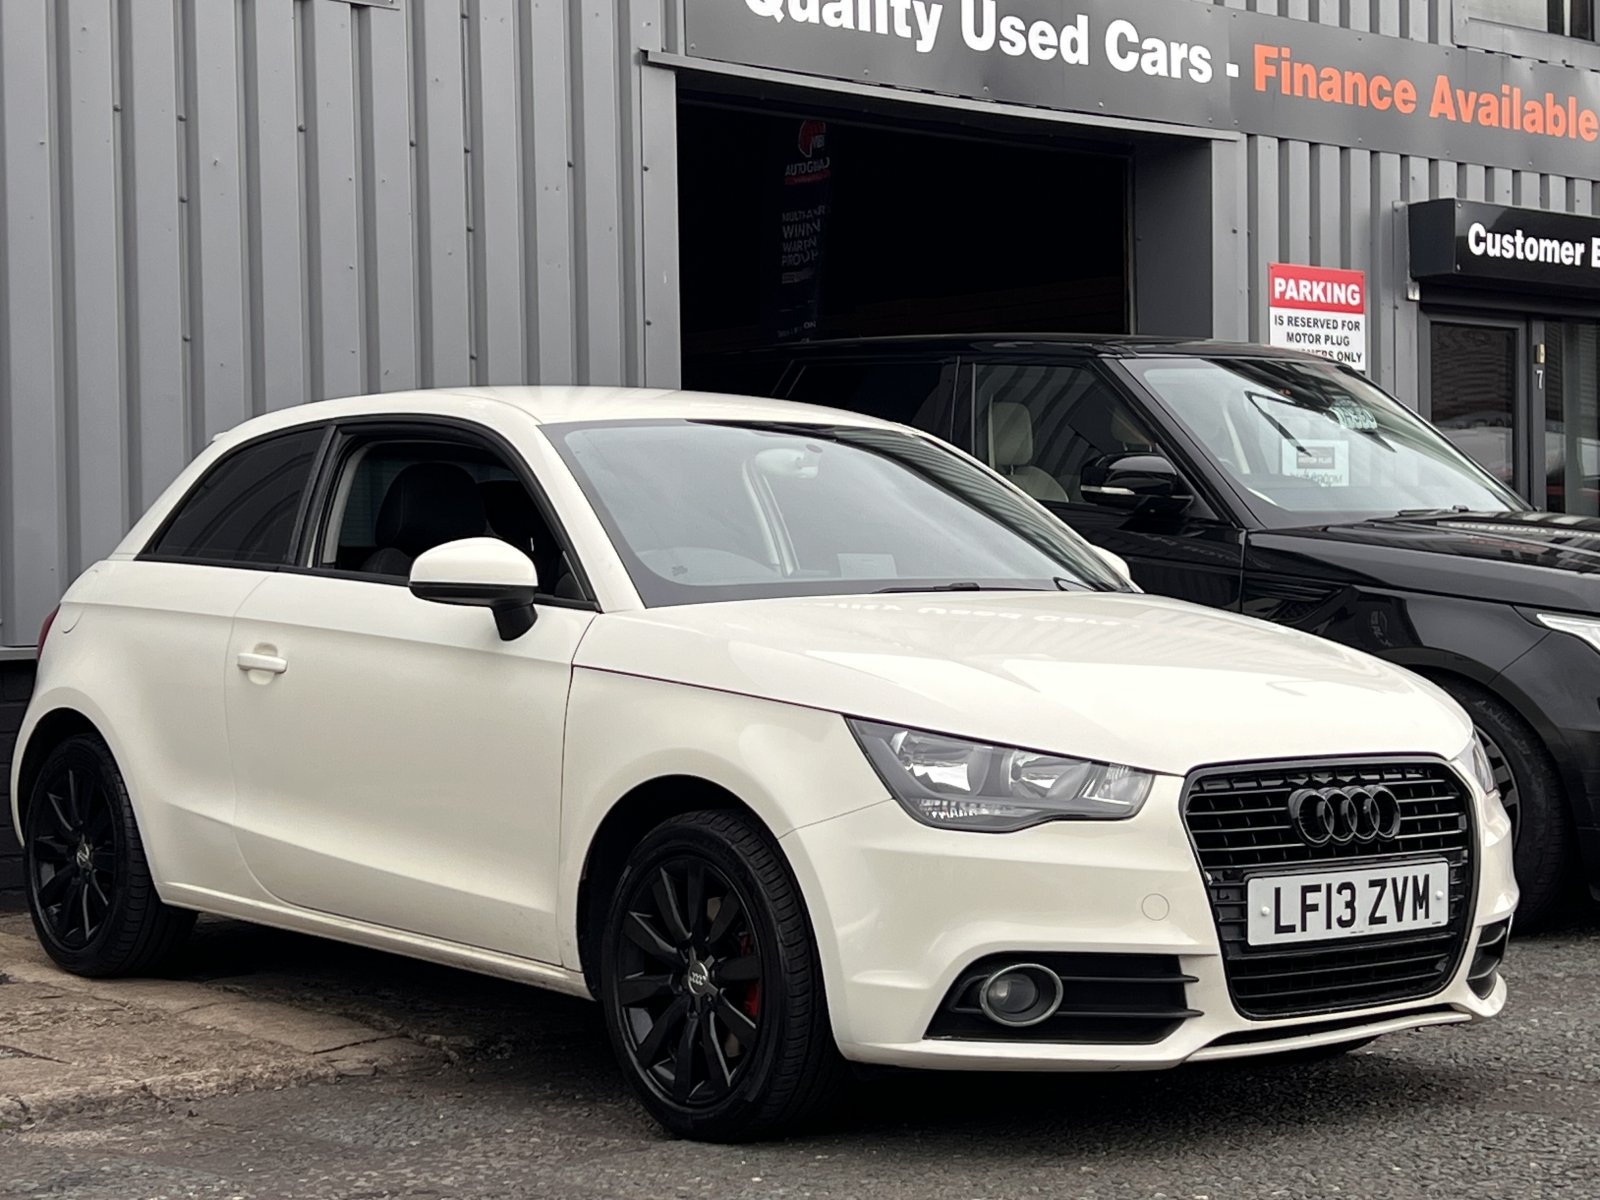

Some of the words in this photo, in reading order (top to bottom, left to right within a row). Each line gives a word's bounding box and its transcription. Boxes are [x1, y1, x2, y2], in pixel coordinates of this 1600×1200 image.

[961, 0, 1089, 65] Used
[1105, 19, 1212, 84] Cars
[1254, 44, 1417, 114] Finance
[1429, 74, 1599, 142] Available
[1468, 222, 1585, 266] Customer
[1274, 277, 1360, 306] PARKING
[1274, 315, 1284, 326] IS
[1287, 316, 1339, 330] RESERVED
[1341, 320, 1361, 332] FOR
[1286, 332, 1321, 345] MOTOR
[1324, 334, 1350, 347] PLUG
[1336, 351, 1362, 363] ONLY
[1536, 370, 1543, 389] 7
[1274, 881, 1356, 935] LF13
[1368, 874, 1430, 926] ZVM
